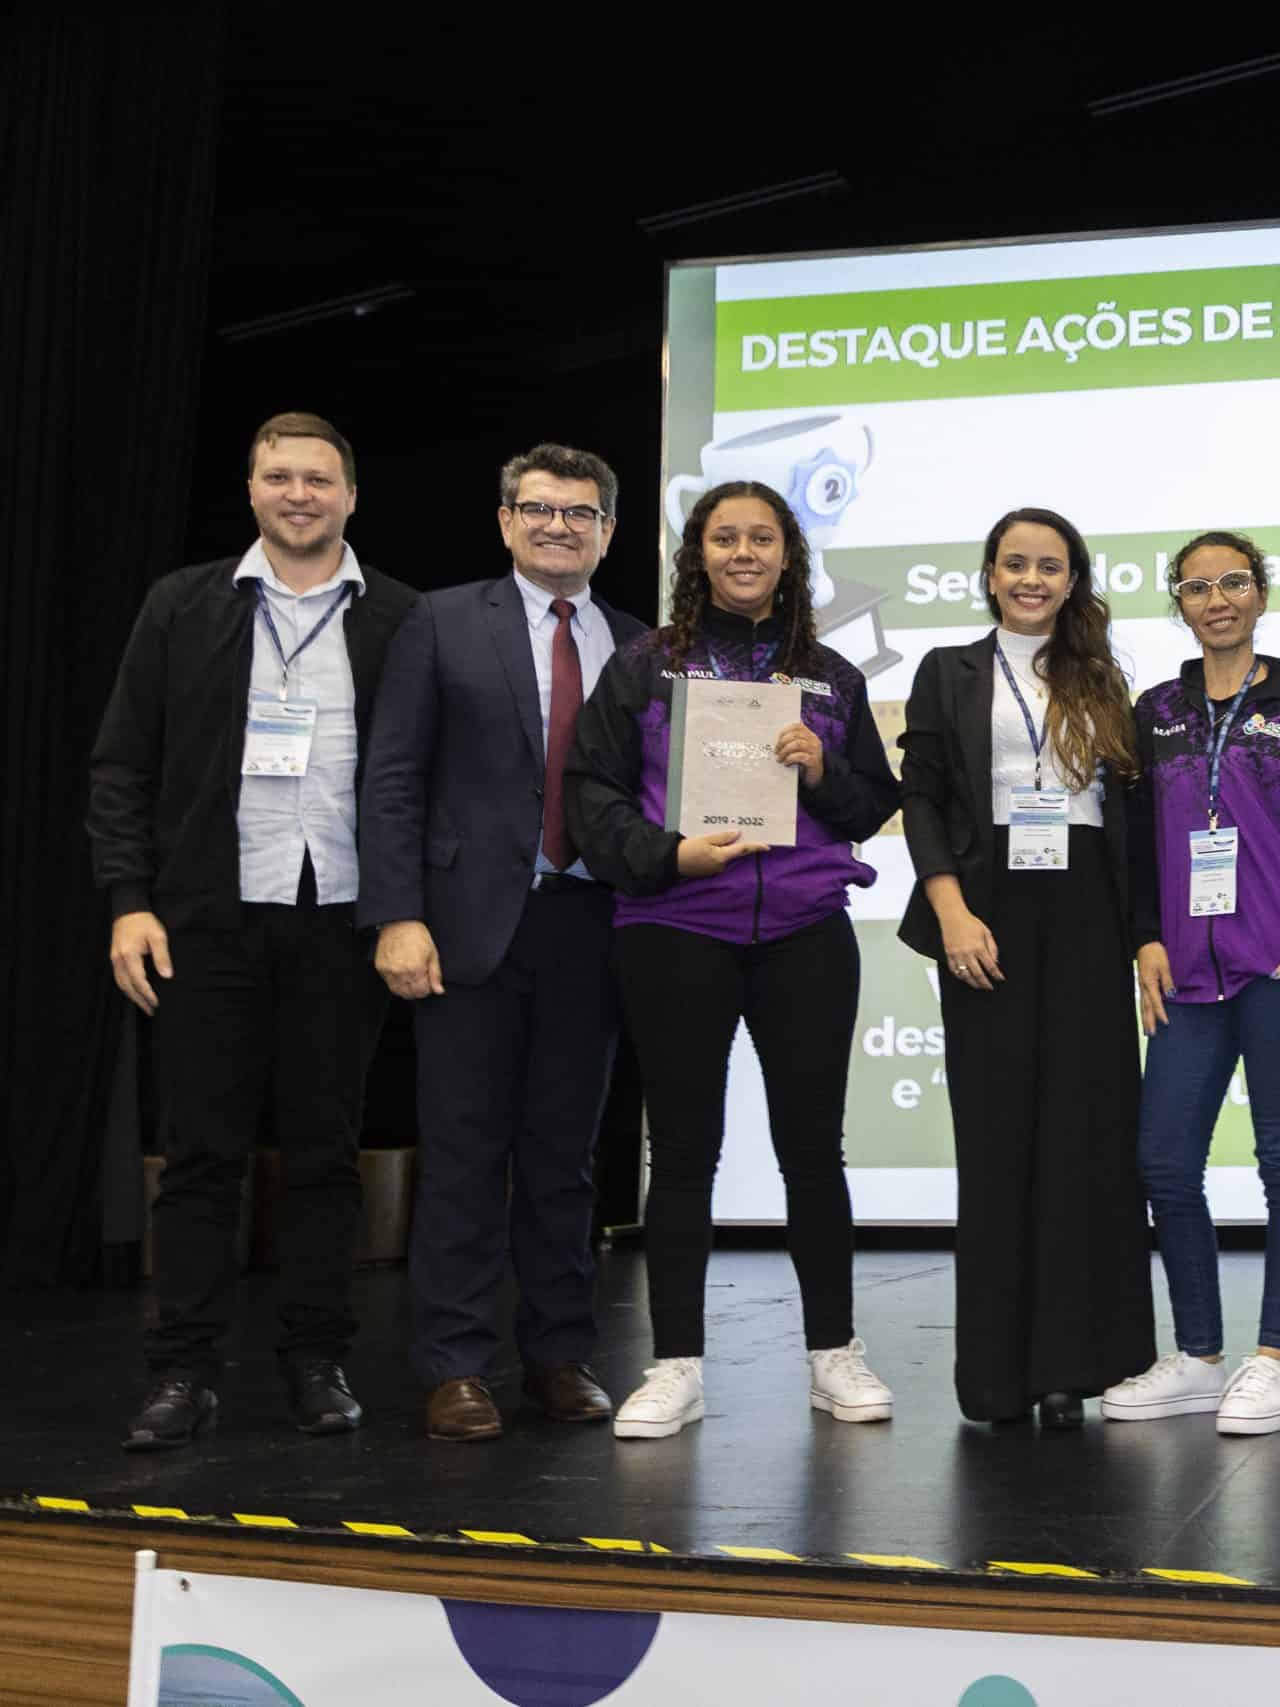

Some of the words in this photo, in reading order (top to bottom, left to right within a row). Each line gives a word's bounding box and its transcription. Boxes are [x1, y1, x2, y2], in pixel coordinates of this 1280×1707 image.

[741, 319, 1008, 371] DESTAQUE
[1015, 302, 1193, 362] AÇÕES
[1203, 302, 1274, 342] DE
[825, 479, 841, 503] 2
[905, 553, 1143, 610] Segdo
[660, 669, 685, 680] ANA
[687, 669, 718, 680] PAUL
[703, 815, 728, 825] 2019
[738, 816, 765, 827] 2022
[863, 1016, 945, 1057] des
[891, 1079, 922, 1109] e
